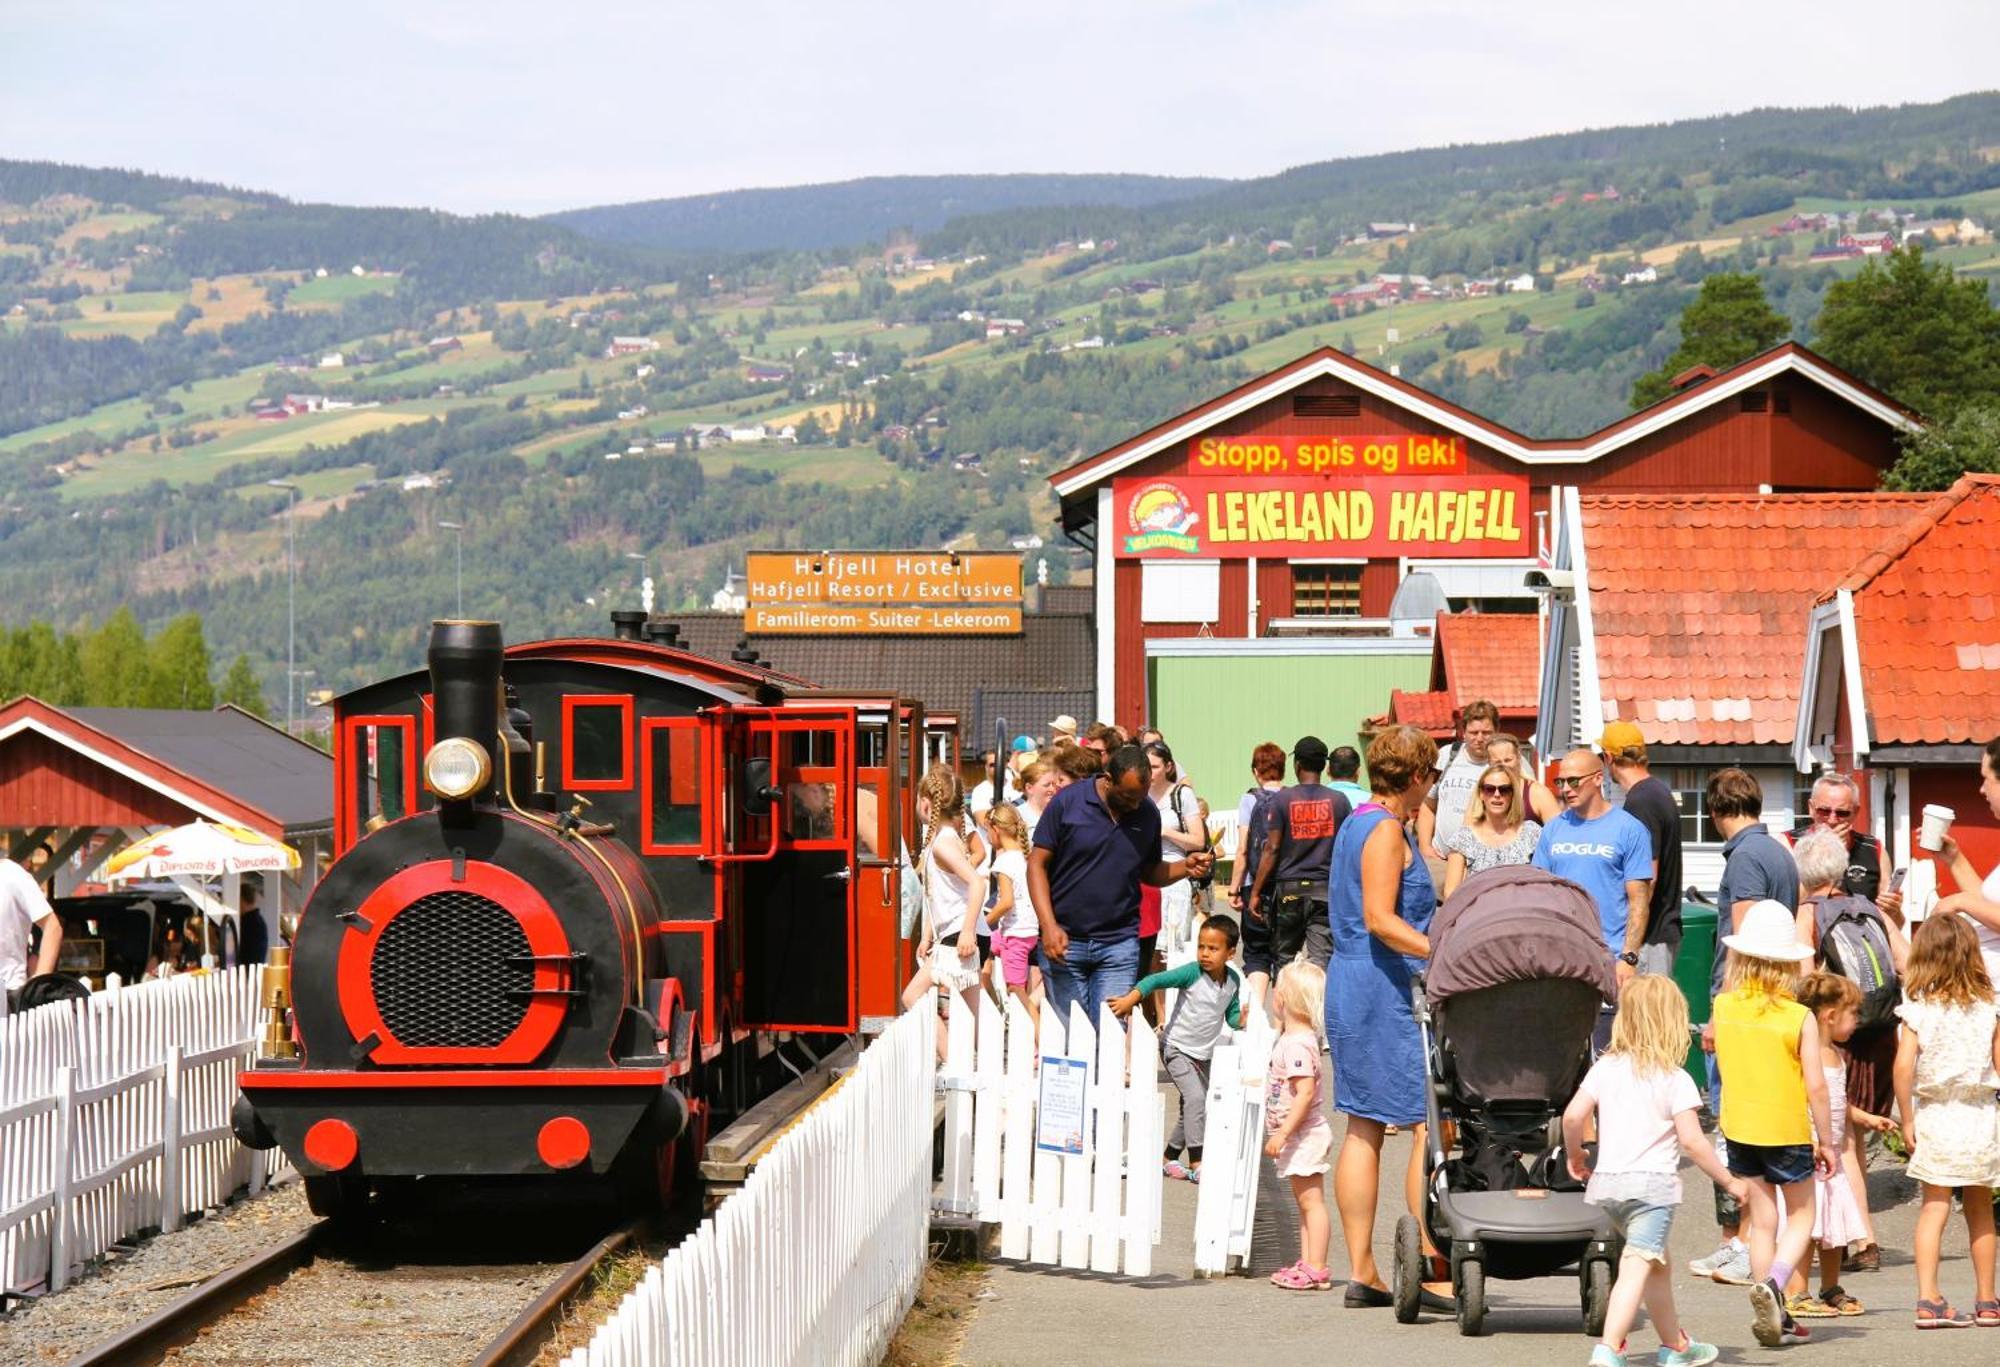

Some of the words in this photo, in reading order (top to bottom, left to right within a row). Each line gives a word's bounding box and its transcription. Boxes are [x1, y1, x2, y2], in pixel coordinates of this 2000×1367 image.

[1198, 438, 1288, 473] Stopp,
[1296, 437, 1355, 473] spis
[1363, 444, 1399, 473] og
[1407, 437, 1456, 465] lek!
[1207, 489, 1374, 542] LEKELAND
[1388, 488, 1521, 543] HAFJELL
[752, 581, 820, 600] Hafjell
[828, 581, 894, 597] Resort
[919, 580, 1013, 597] Exclusive
[757, 611, 863, 627] Familierom-
[868, 611, 921, 627] Suiter
[927, 611, 1010, 627] -Lekerom
[1551, 842, 1615, 859] ROGUE
